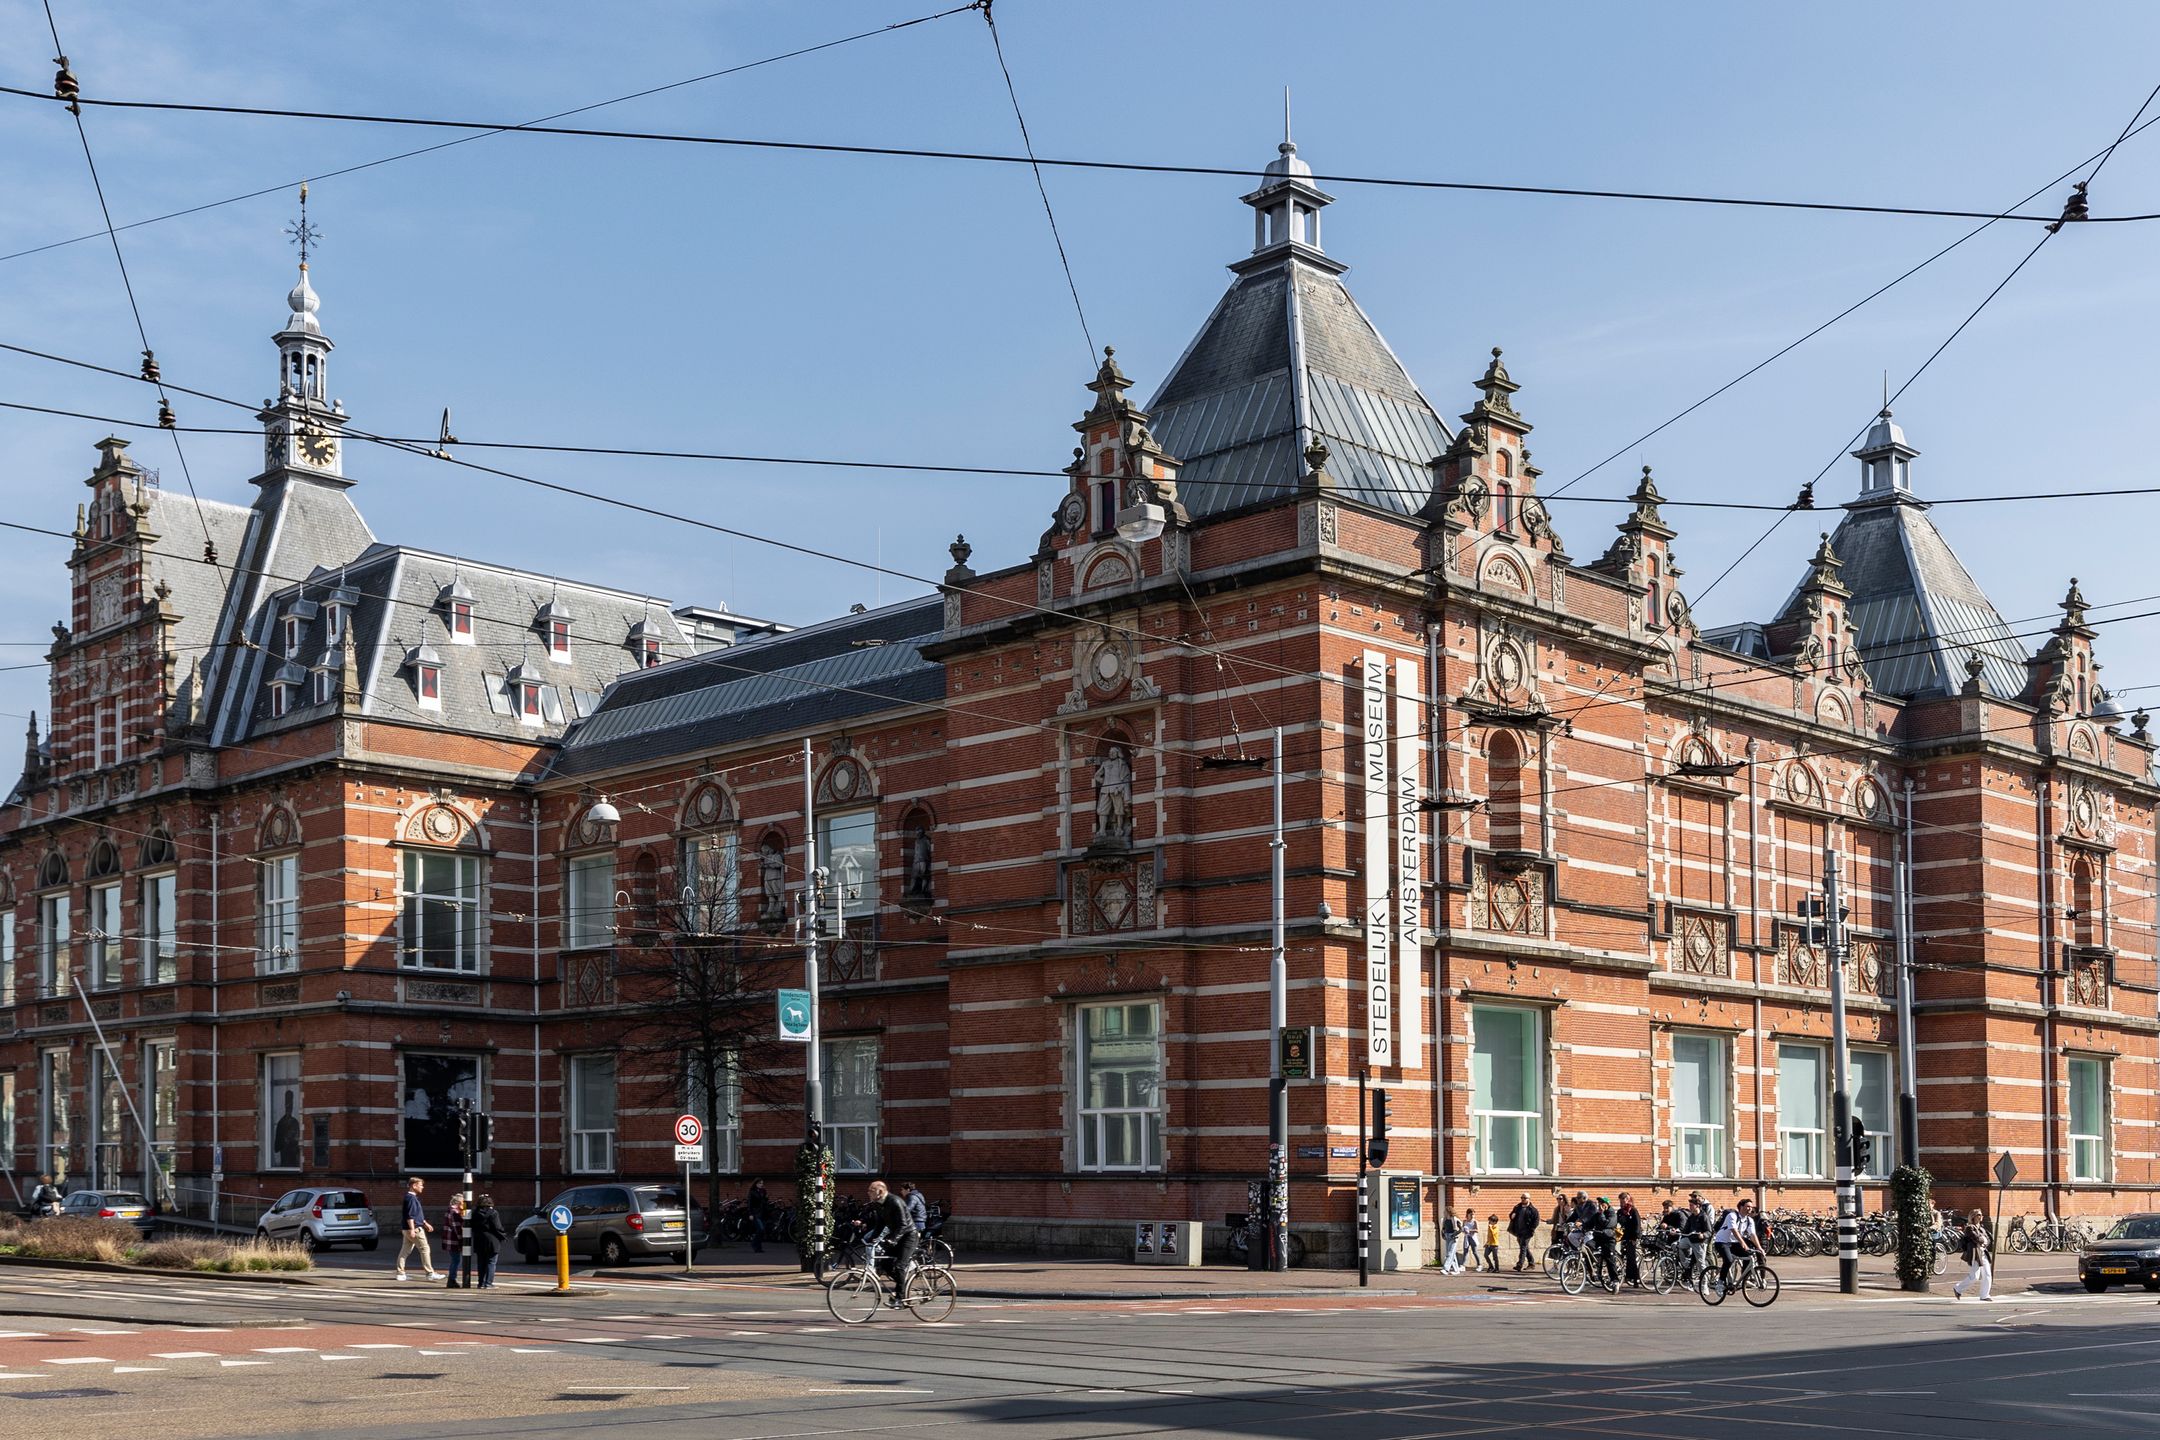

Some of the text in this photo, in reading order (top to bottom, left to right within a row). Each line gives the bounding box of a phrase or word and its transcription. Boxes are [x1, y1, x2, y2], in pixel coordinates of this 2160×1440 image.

[1369, 662, 1387, 1054] STEDELIJK MUSEUM
[1402, 776, 1418, 945] AMSTERDAM
[681, 1125, 697, 1136] 30
